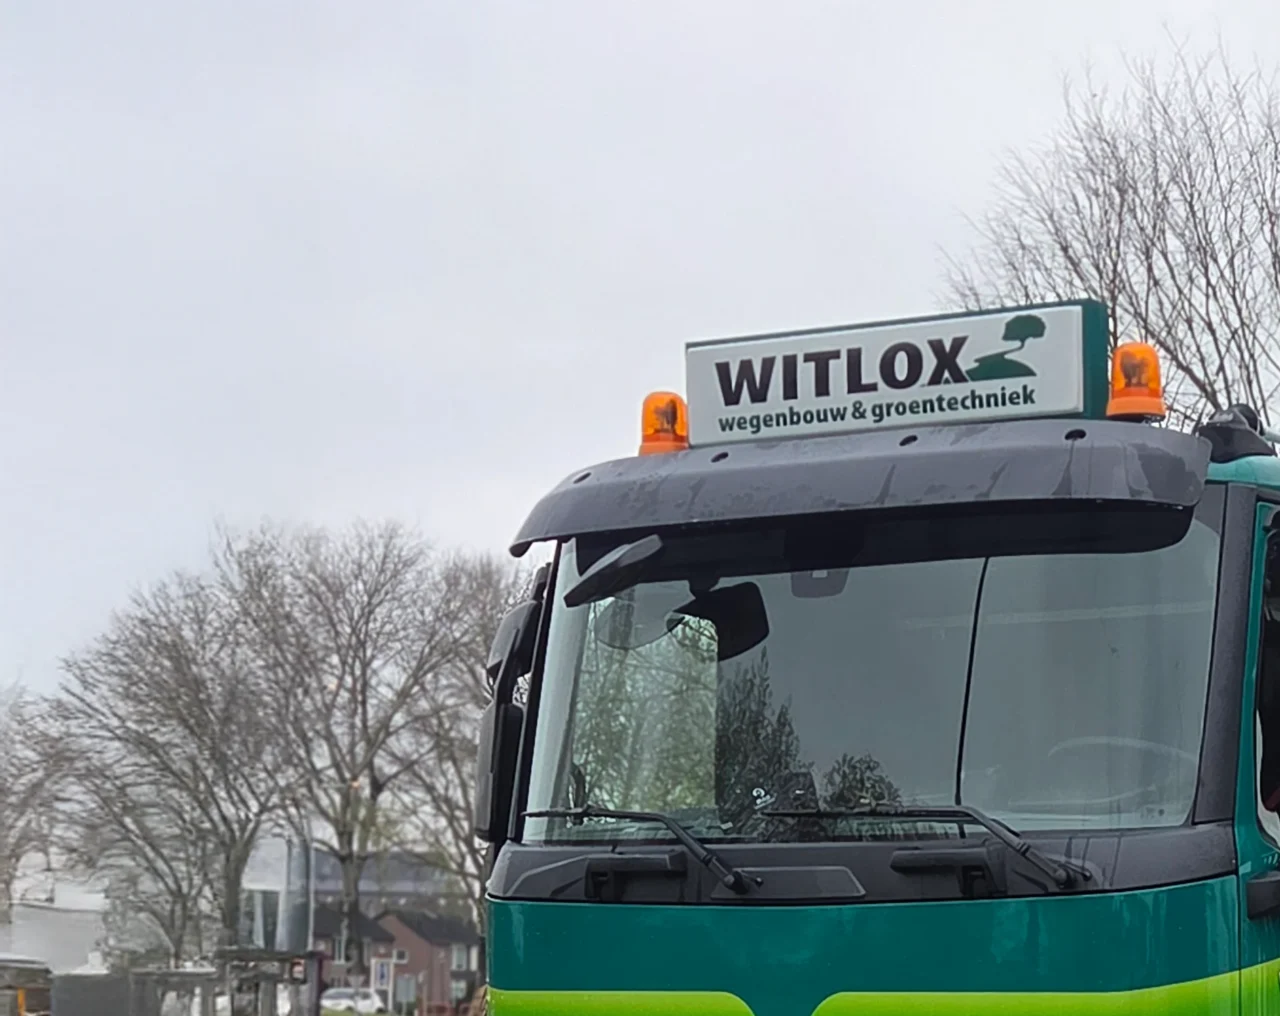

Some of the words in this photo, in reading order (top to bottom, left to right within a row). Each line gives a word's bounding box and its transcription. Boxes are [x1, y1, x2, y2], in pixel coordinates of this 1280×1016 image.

[715, 335, 971, 407] WITLOX
[718, 403, 848, 433] wegenbouw
[852, 401, 867, 420] &
[872, 385, 1036, 423] groentechniek
